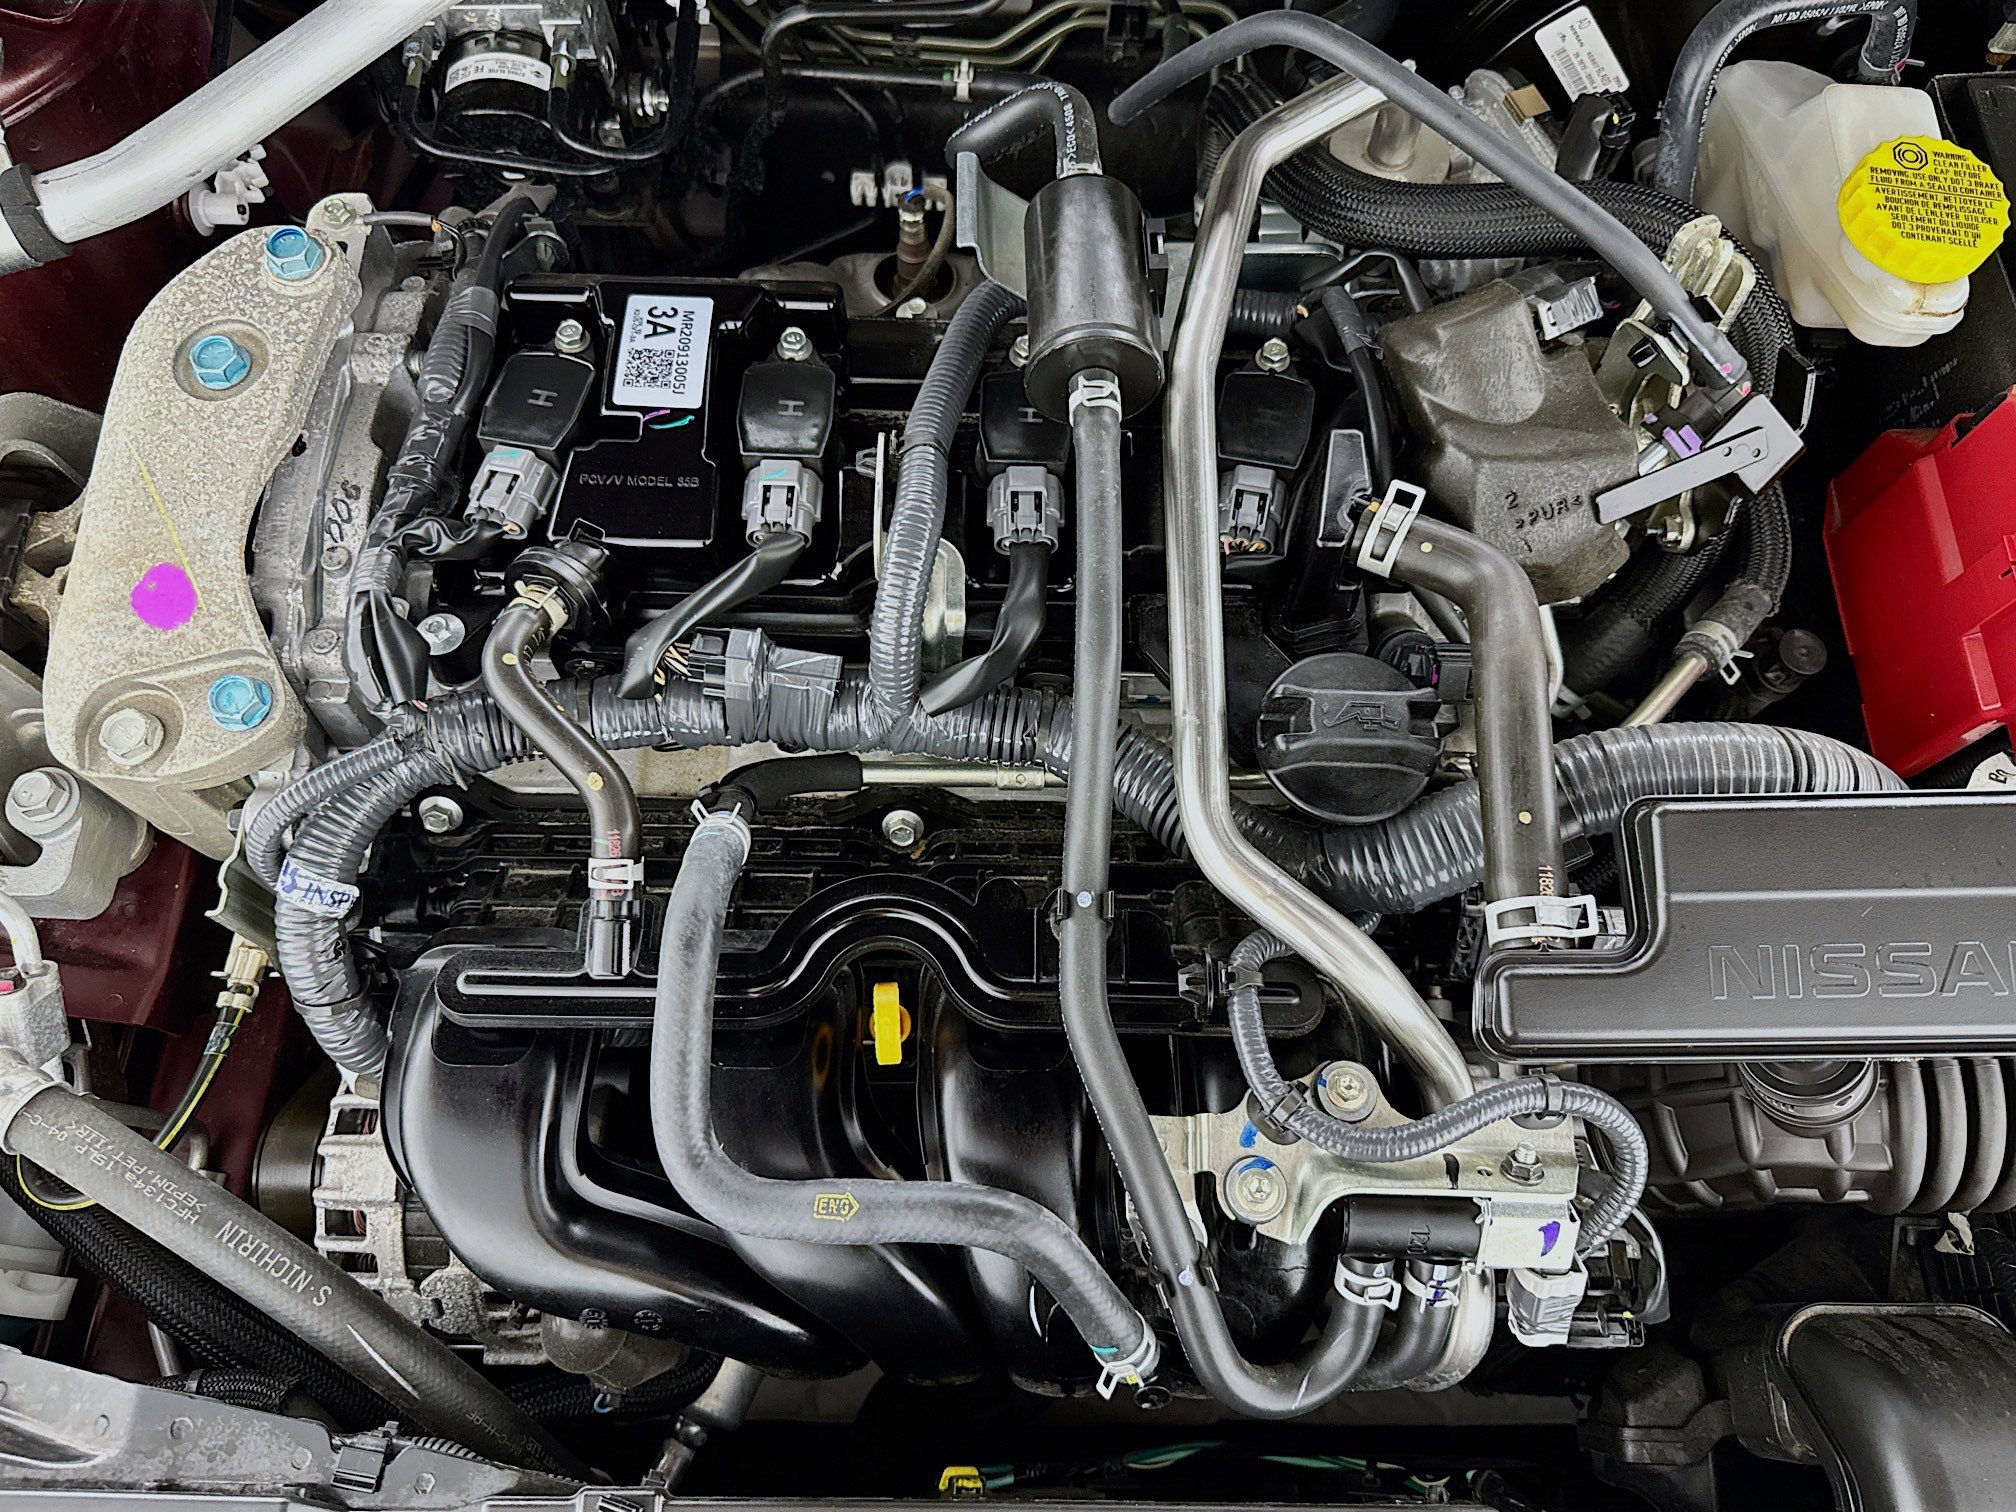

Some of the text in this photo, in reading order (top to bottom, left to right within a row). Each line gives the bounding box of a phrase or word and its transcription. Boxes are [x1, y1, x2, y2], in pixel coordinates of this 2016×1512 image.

[1933, 160, 1987, 173] CLEAN FILLER
[1934, 167, 1982, 180] CAP BEFORE
[1871, 175, 1893, 184] FLUID
[1896, 178, 1917, 187] FROM
[1927, 181, 1958, 193] SEALED
[1912, 172, 1926, 180] USE
[1928, 174, 1948, 184] ONLY
[1950, 177, 1964, 186] DOT
[1974, 180, 1999, 190] BRAKE
[1885, 196, 1986, 215] BOUCHON DE REMPLISSAGE
[1943, 196, 1983, 208] NETTOYER
[1985, 201, 1994, 209] LE
[1876, 203, 1904, 213] AVANT
[1906, 206, 1916, 214] DE
[1964, 214, 1998, 225] UTILISER
[1891, 213, 1979, 231] SEULEMENT DU LIQUIDE
[1891, 221, 1906, 229] DOT
[1915, 224, 1961, 237] PROVENANT
[1900, 231, 1946, 244] CONTENANT
[644, 306, 678, 339] 3A
[672, 310, 695, 395] MR20913005J
[627, 475, 673, 488] MODEL
[1505, 489, 1519, 510] 2
[1708, 941, 2016, 999] NISSA
[75, 1144, 114, 1171] 15LP
[124, 1171, 201, 1225] HFC134a
[818, 1198, 850, 1215] ENG
